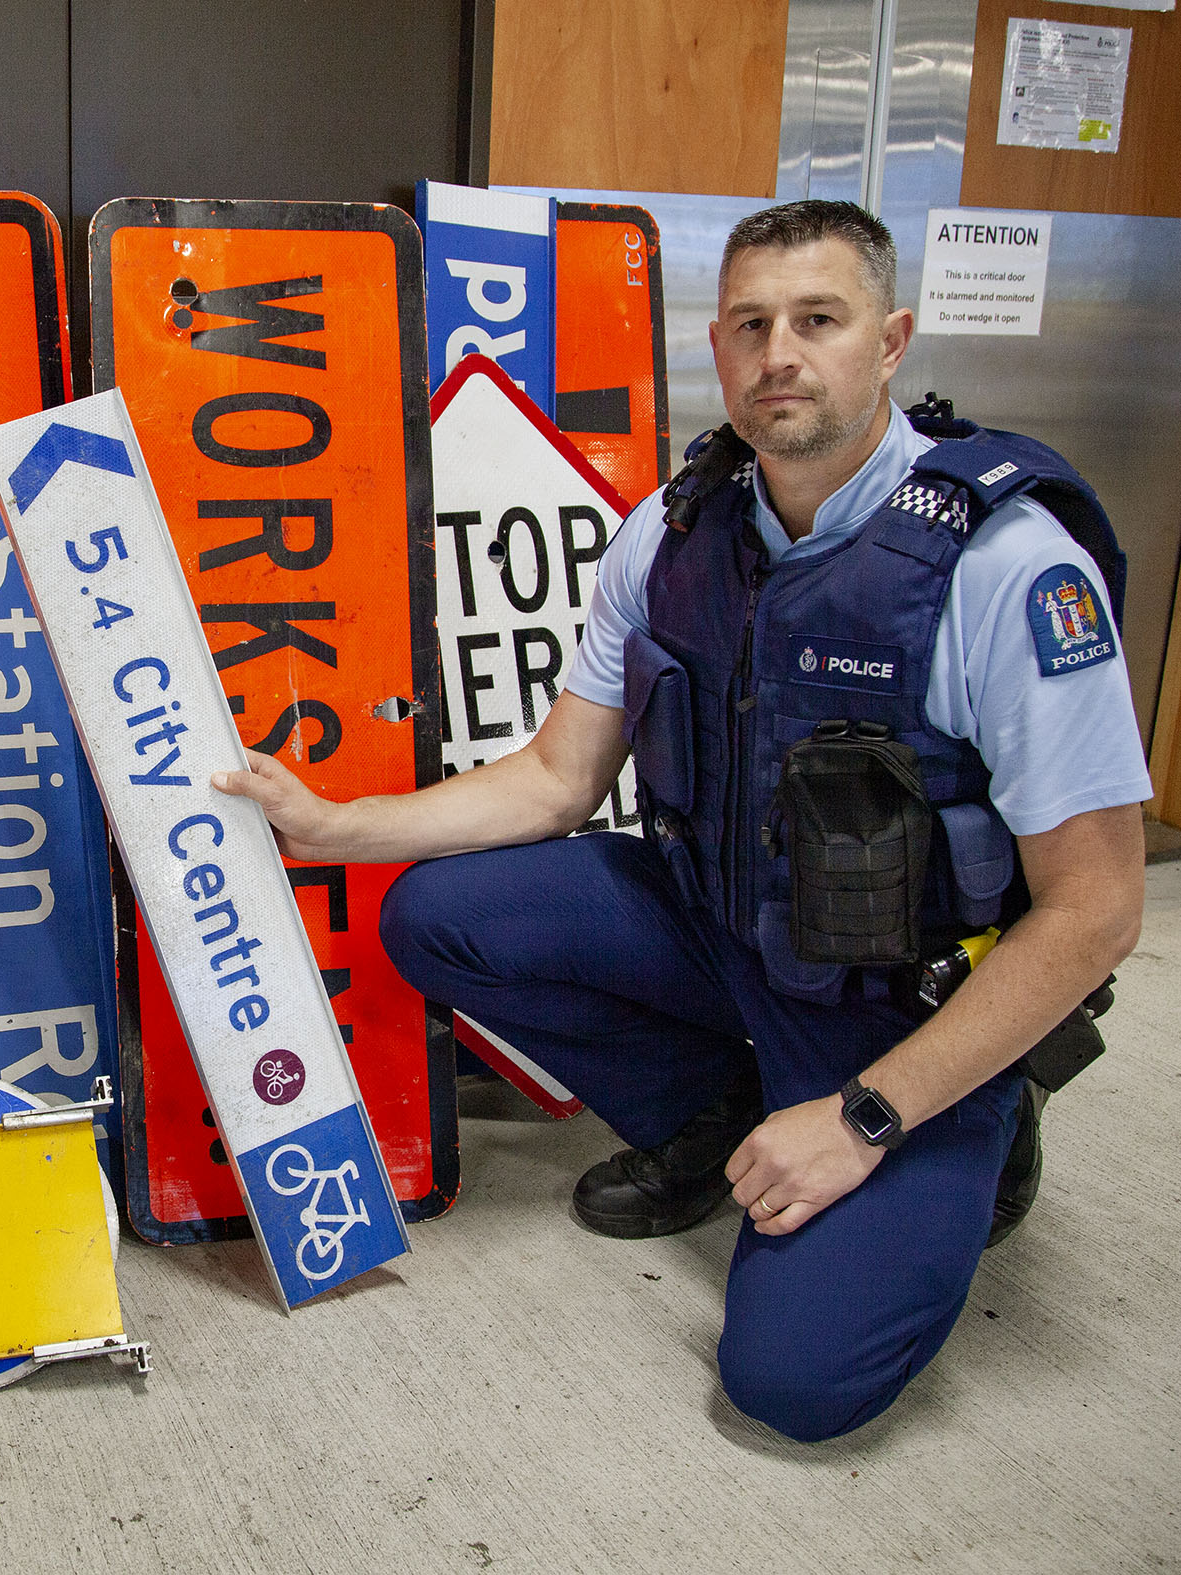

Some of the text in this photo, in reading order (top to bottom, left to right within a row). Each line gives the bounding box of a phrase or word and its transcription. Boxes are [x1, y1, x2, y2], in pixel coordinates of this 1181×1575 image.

[937, 223, 1039, 246] ATTENTION
[624, 231, 644, 287] FCC
[945, 269, 1026, 282] This is a critical door
[929, 290, 1035, 303] It is alarmed and monitored
[445, 257, 527, 392] Rd
[939, 311, 1021, 324] Do not wedge it open
[190, 274, 343, 765] WORKS
[435, 504, 608, 618] TOP
[827, 656, 895, 679] POLICE
[1051, 641, 1111, 670] POLICE
[65, 526, 271, 1033] 5.4 City Centre
